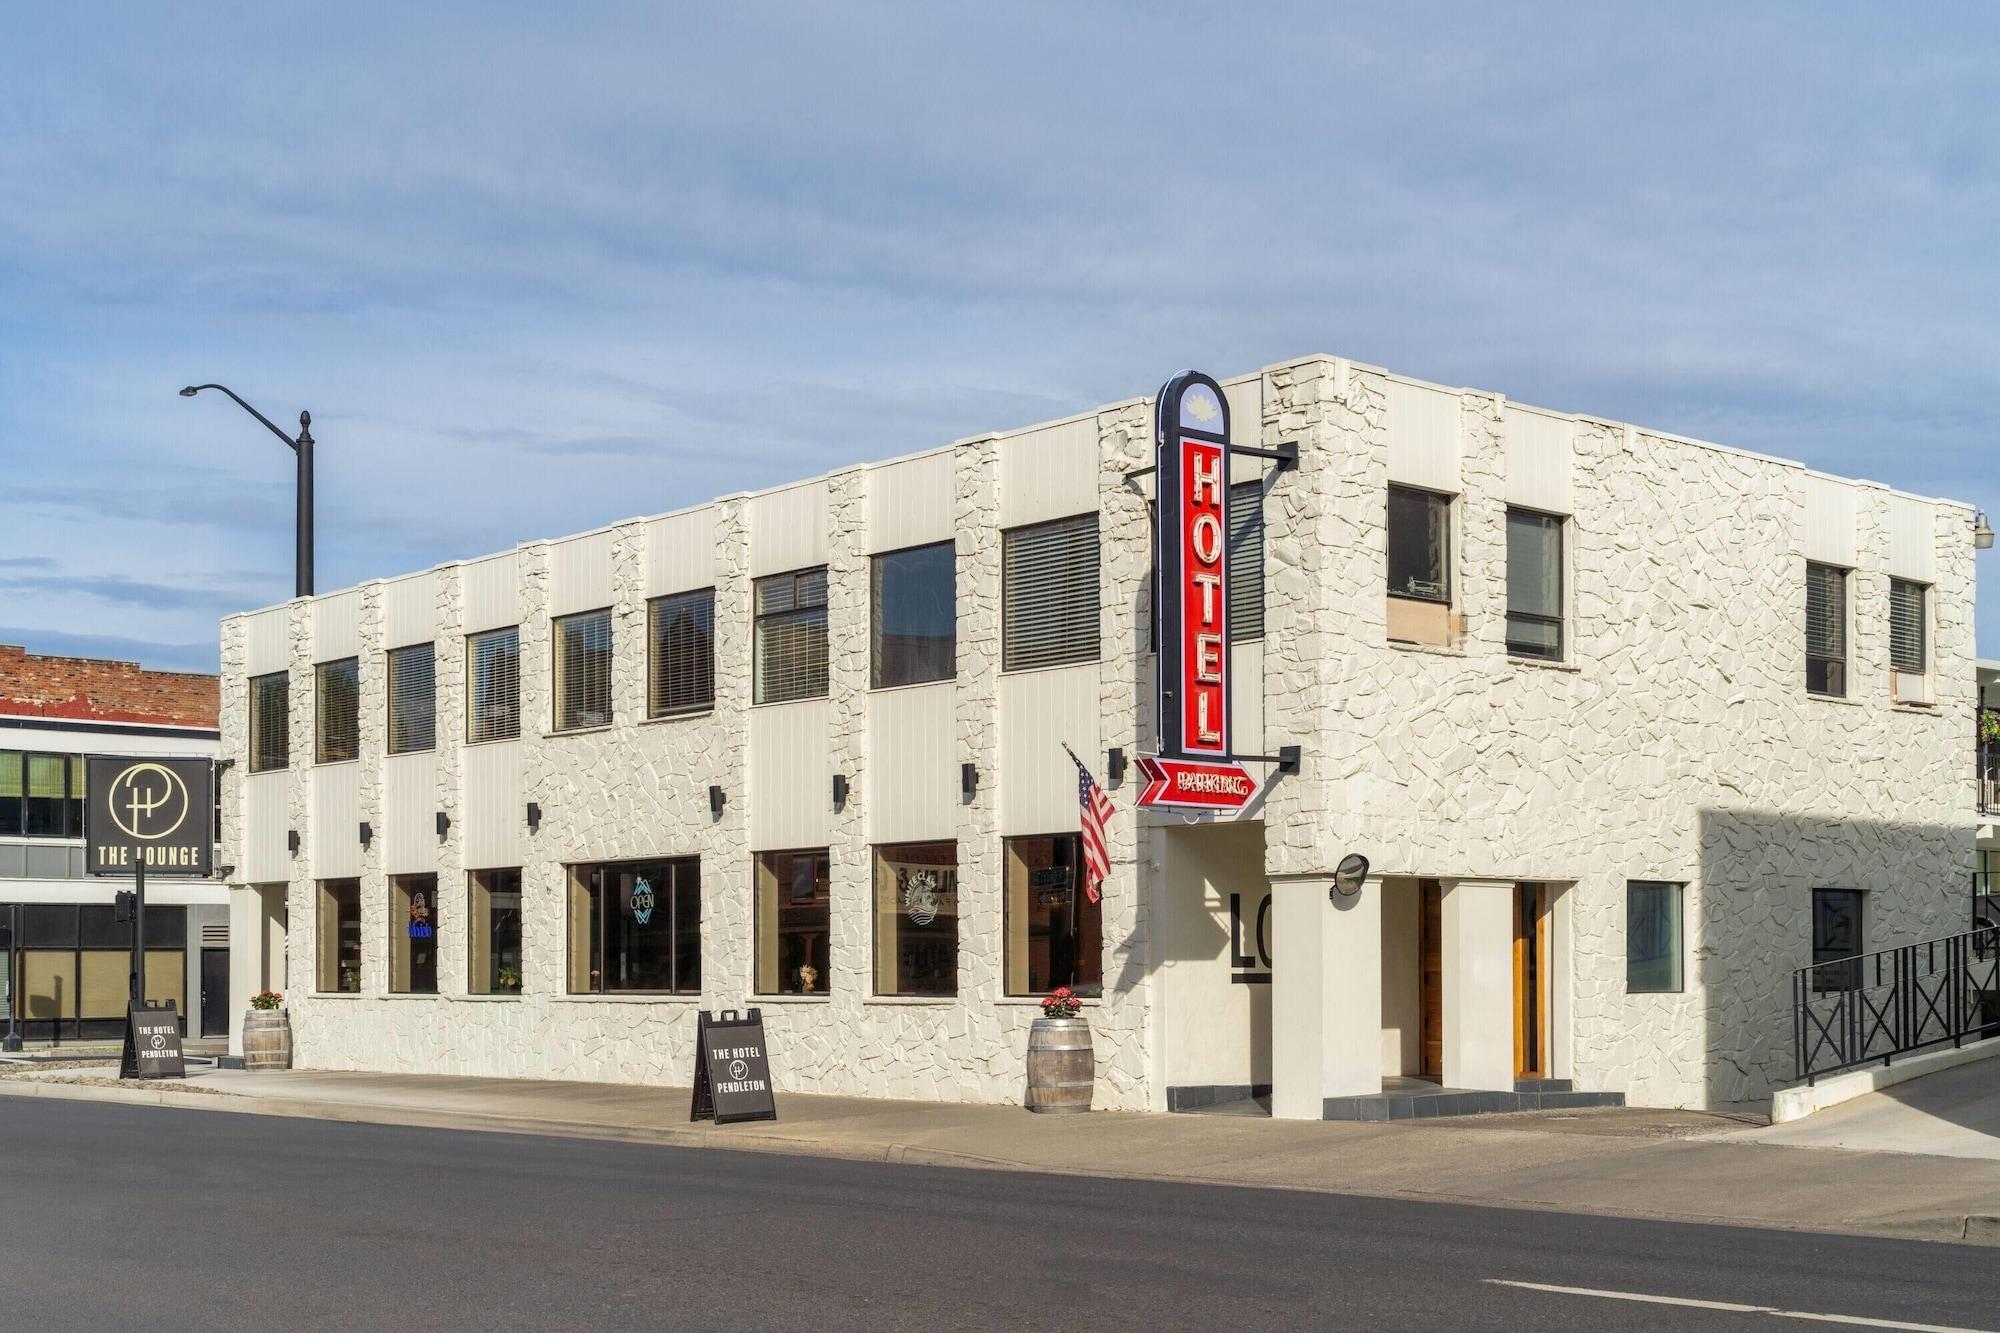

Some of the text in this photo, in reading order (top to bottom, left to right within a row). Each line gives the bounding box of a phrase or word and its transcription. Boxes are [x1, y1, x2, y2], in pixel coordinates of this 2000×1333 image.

[1192, 452, 1222, 742] HOTEL
[1177, 771, 1248, 795] PARKING
[98, 846, 128, 866] THE
[904, 875, 918, 907] WHITE
[917, 871, 937, 888] CLAW
[630, 893, 655, 910] OPEN
[138, 1025, 175, 1035] THE HOTEL
[141, 1049, 179, 1059] PENDLETON
[712, 1047, 761, 1060] THE HOTEL
[717, 1079, 766, 1094] PENDLETON
